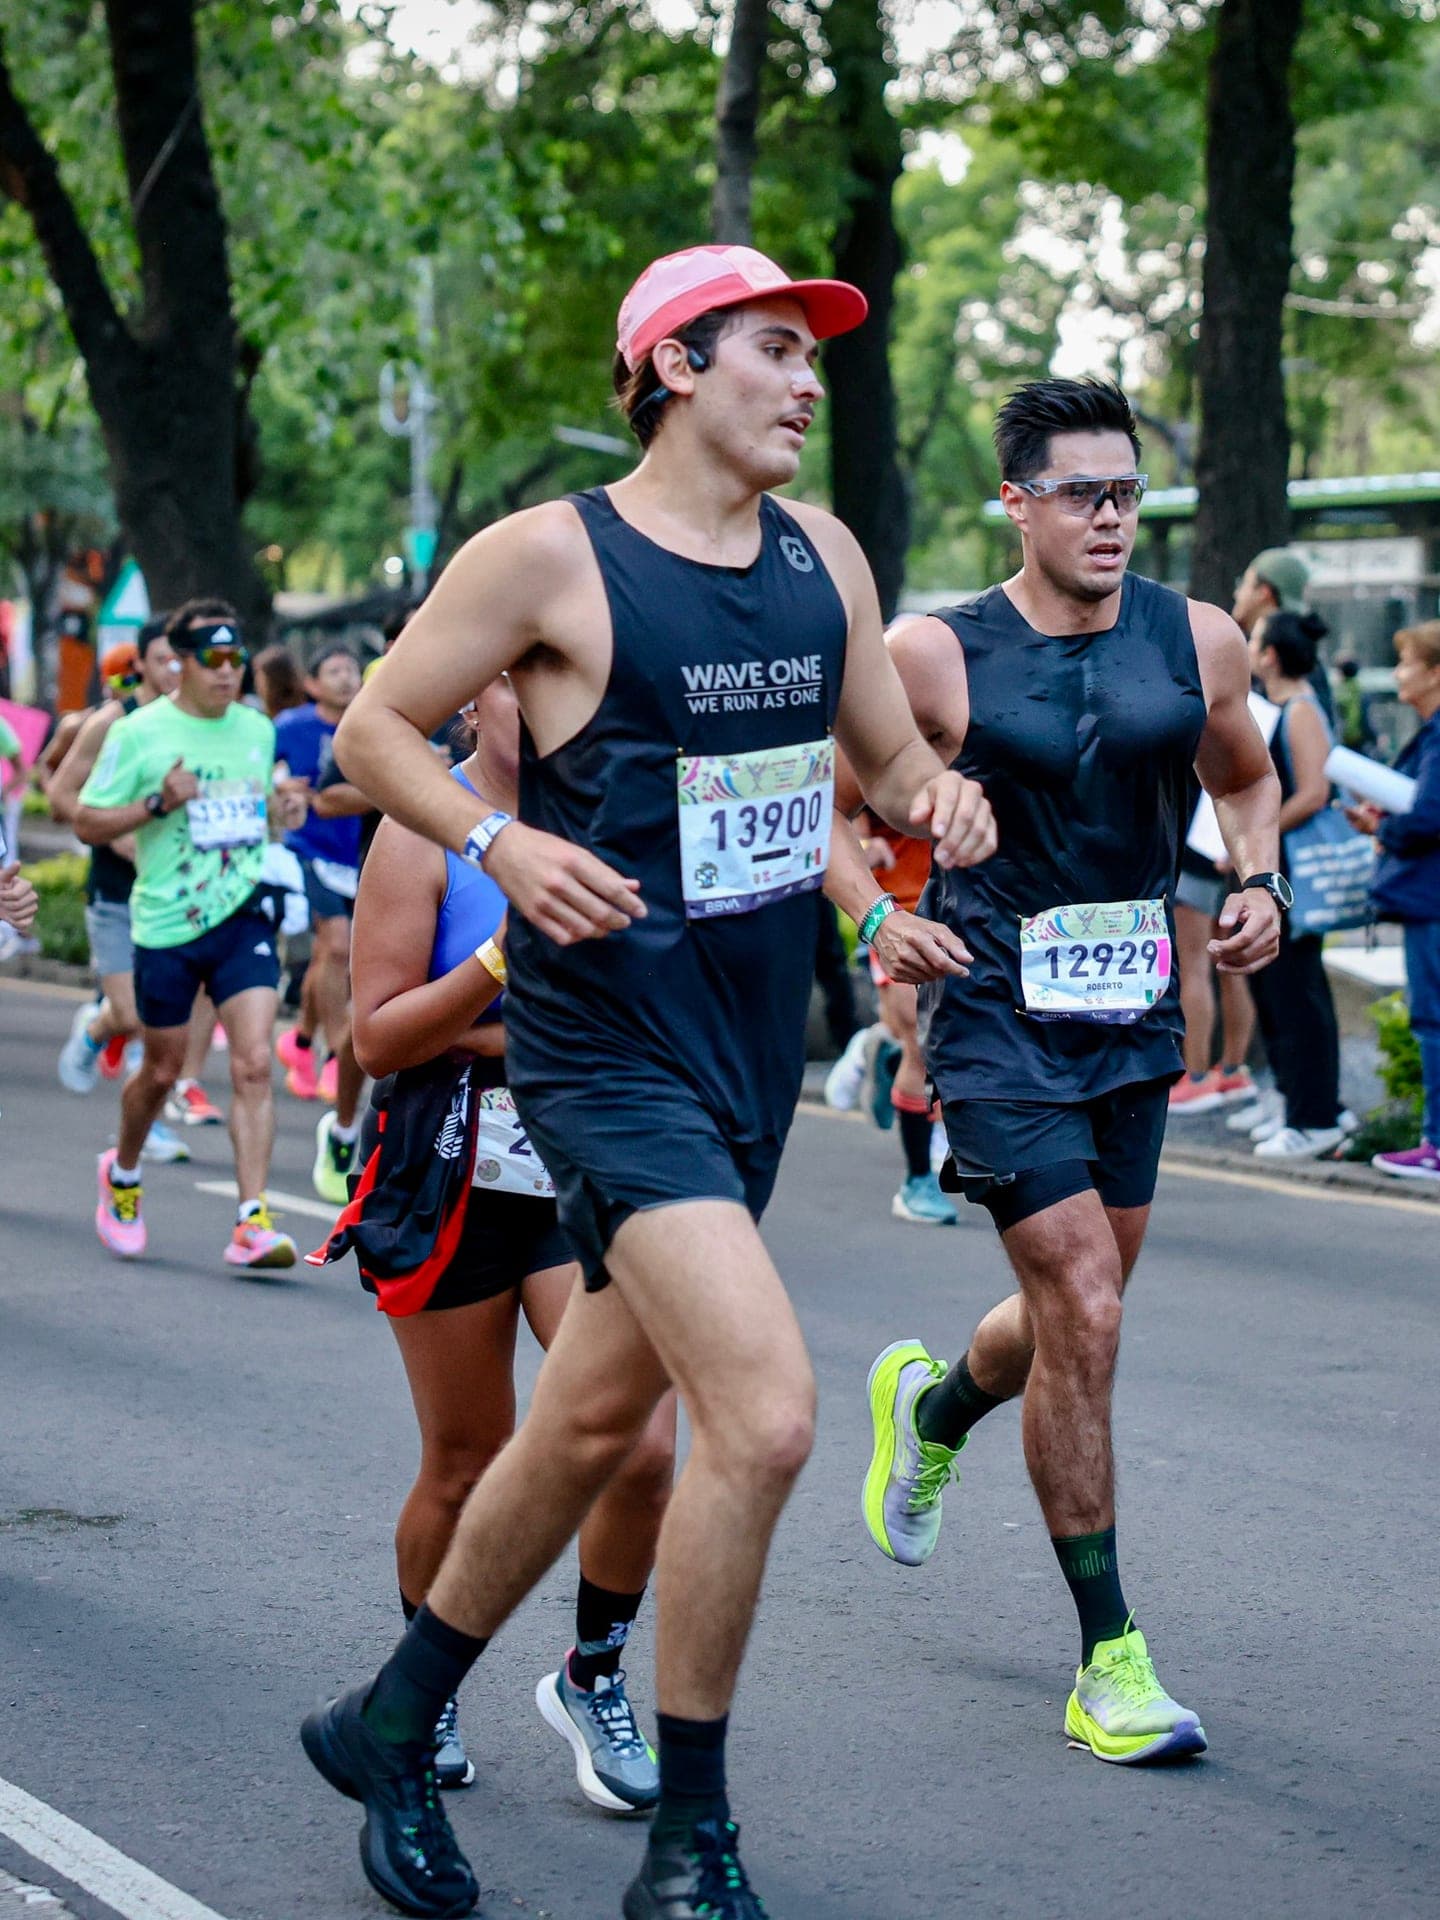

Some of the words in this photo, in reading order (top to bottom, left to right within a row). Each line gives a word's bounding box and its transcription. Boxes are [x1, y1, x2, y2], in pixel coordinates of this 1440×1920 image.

[680, 661, 766, 692] WAVE
[768, 654, 823, 685] ONE
[687, 697, 719, 715] WE
[723, 693, 759, 712] RUN
[763, 691, 786, 709] AS
[789, 687, 821, 706] ONE
[710, 790, 822, 851] 13900
[704, 898, 740, 914] BBVA
[1044, 939, 1159, 979] 12929
[1086, 982, 1123, 991] ROBERTO
